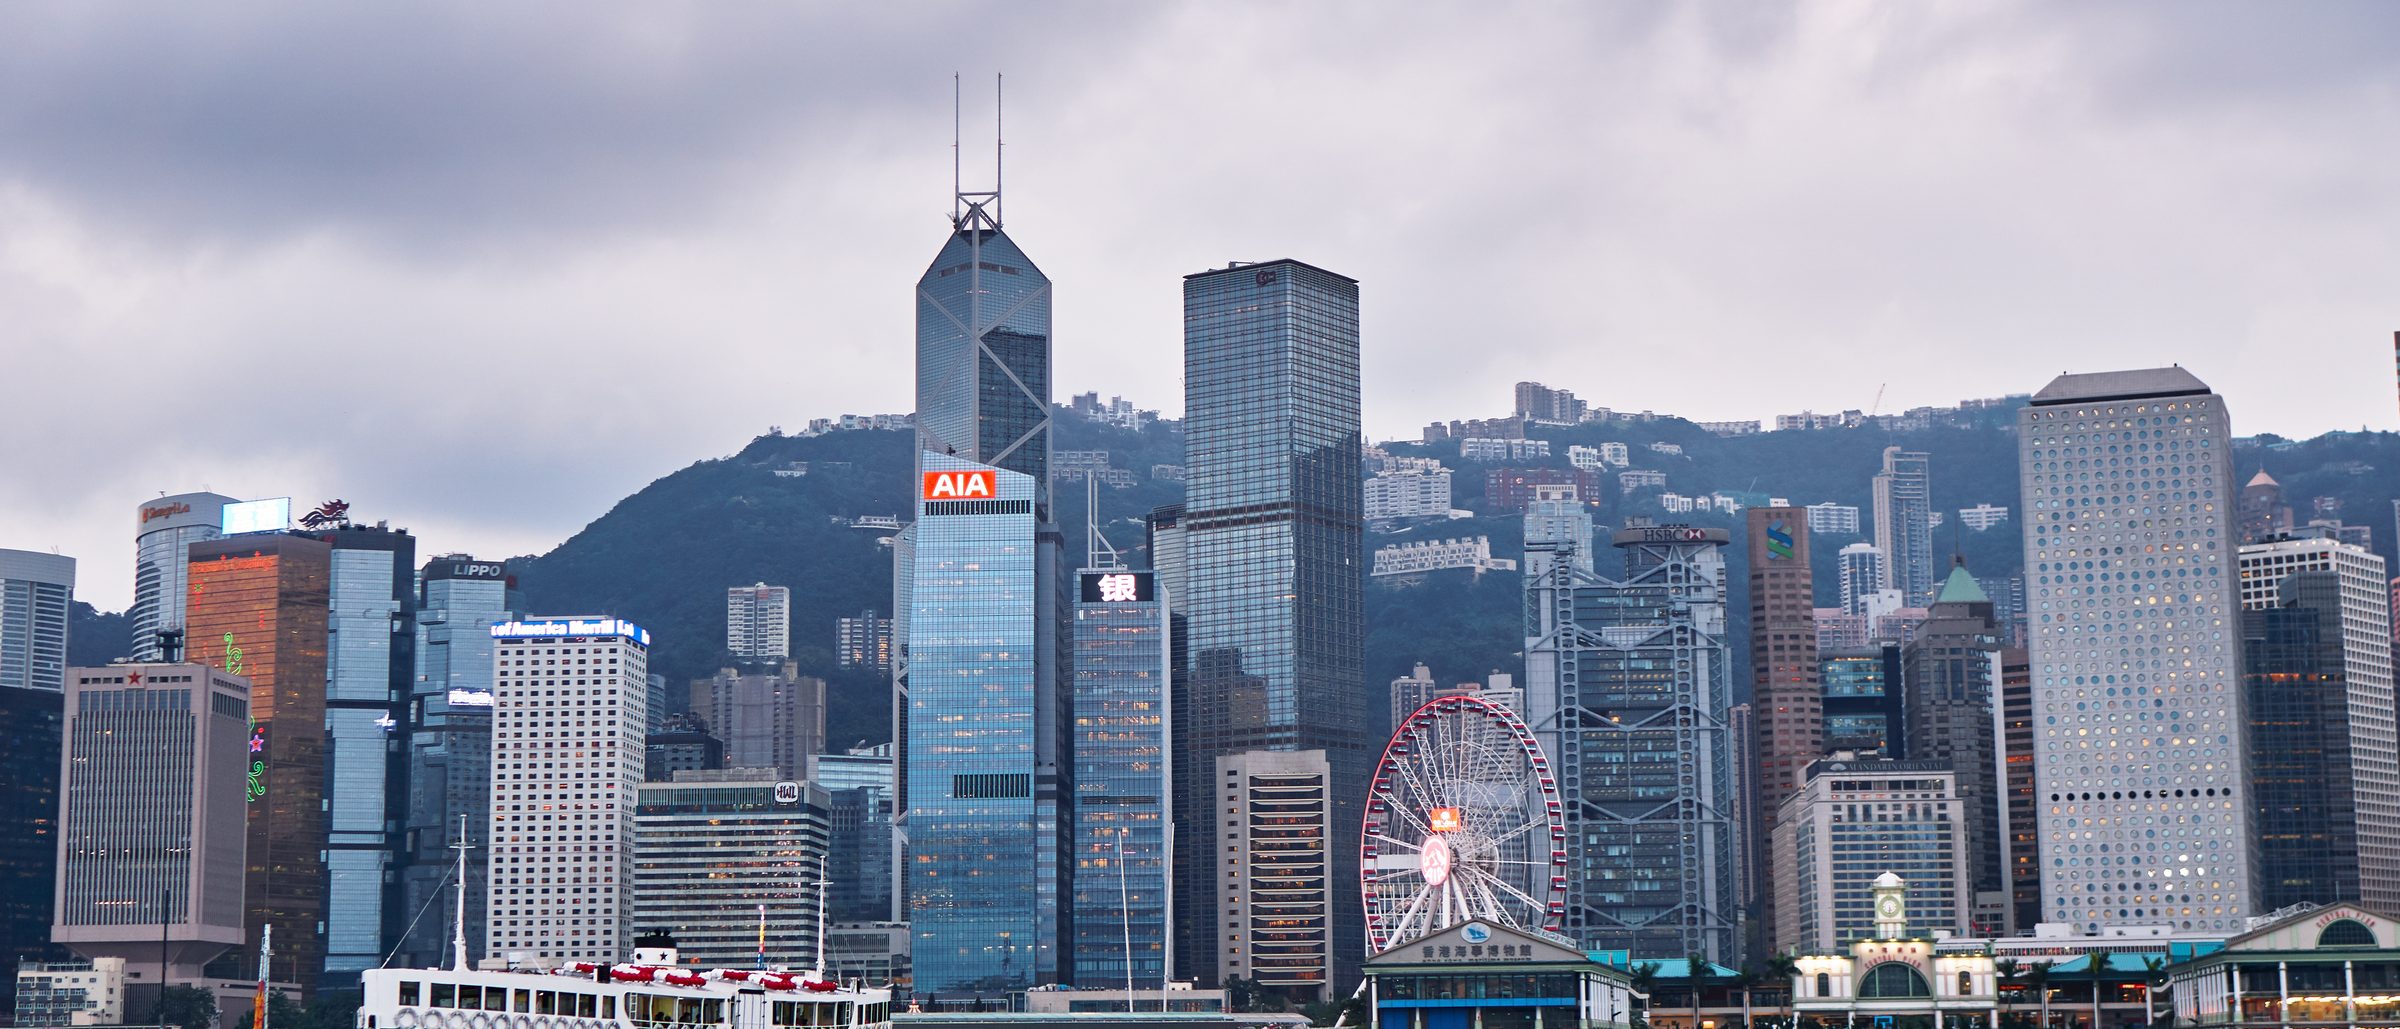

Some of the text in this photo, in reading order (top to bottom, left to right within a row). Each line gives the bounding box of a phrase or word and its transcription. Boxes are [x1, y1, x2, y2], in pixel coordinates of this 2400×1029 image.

[932, 473, 988, 497] AIA
[1644, 529, 1683, 541] HSBC
[454, 564, 501, 576] LIPPO
[1097, 573, 1137, 602] 银
[511, 621, 567, 636] America
[569, 620, 615, 635] Merrill
[1849, 762, 1943, 772] MANDARIN ORIENTAL
[776, 785, 797, 799] HWL
